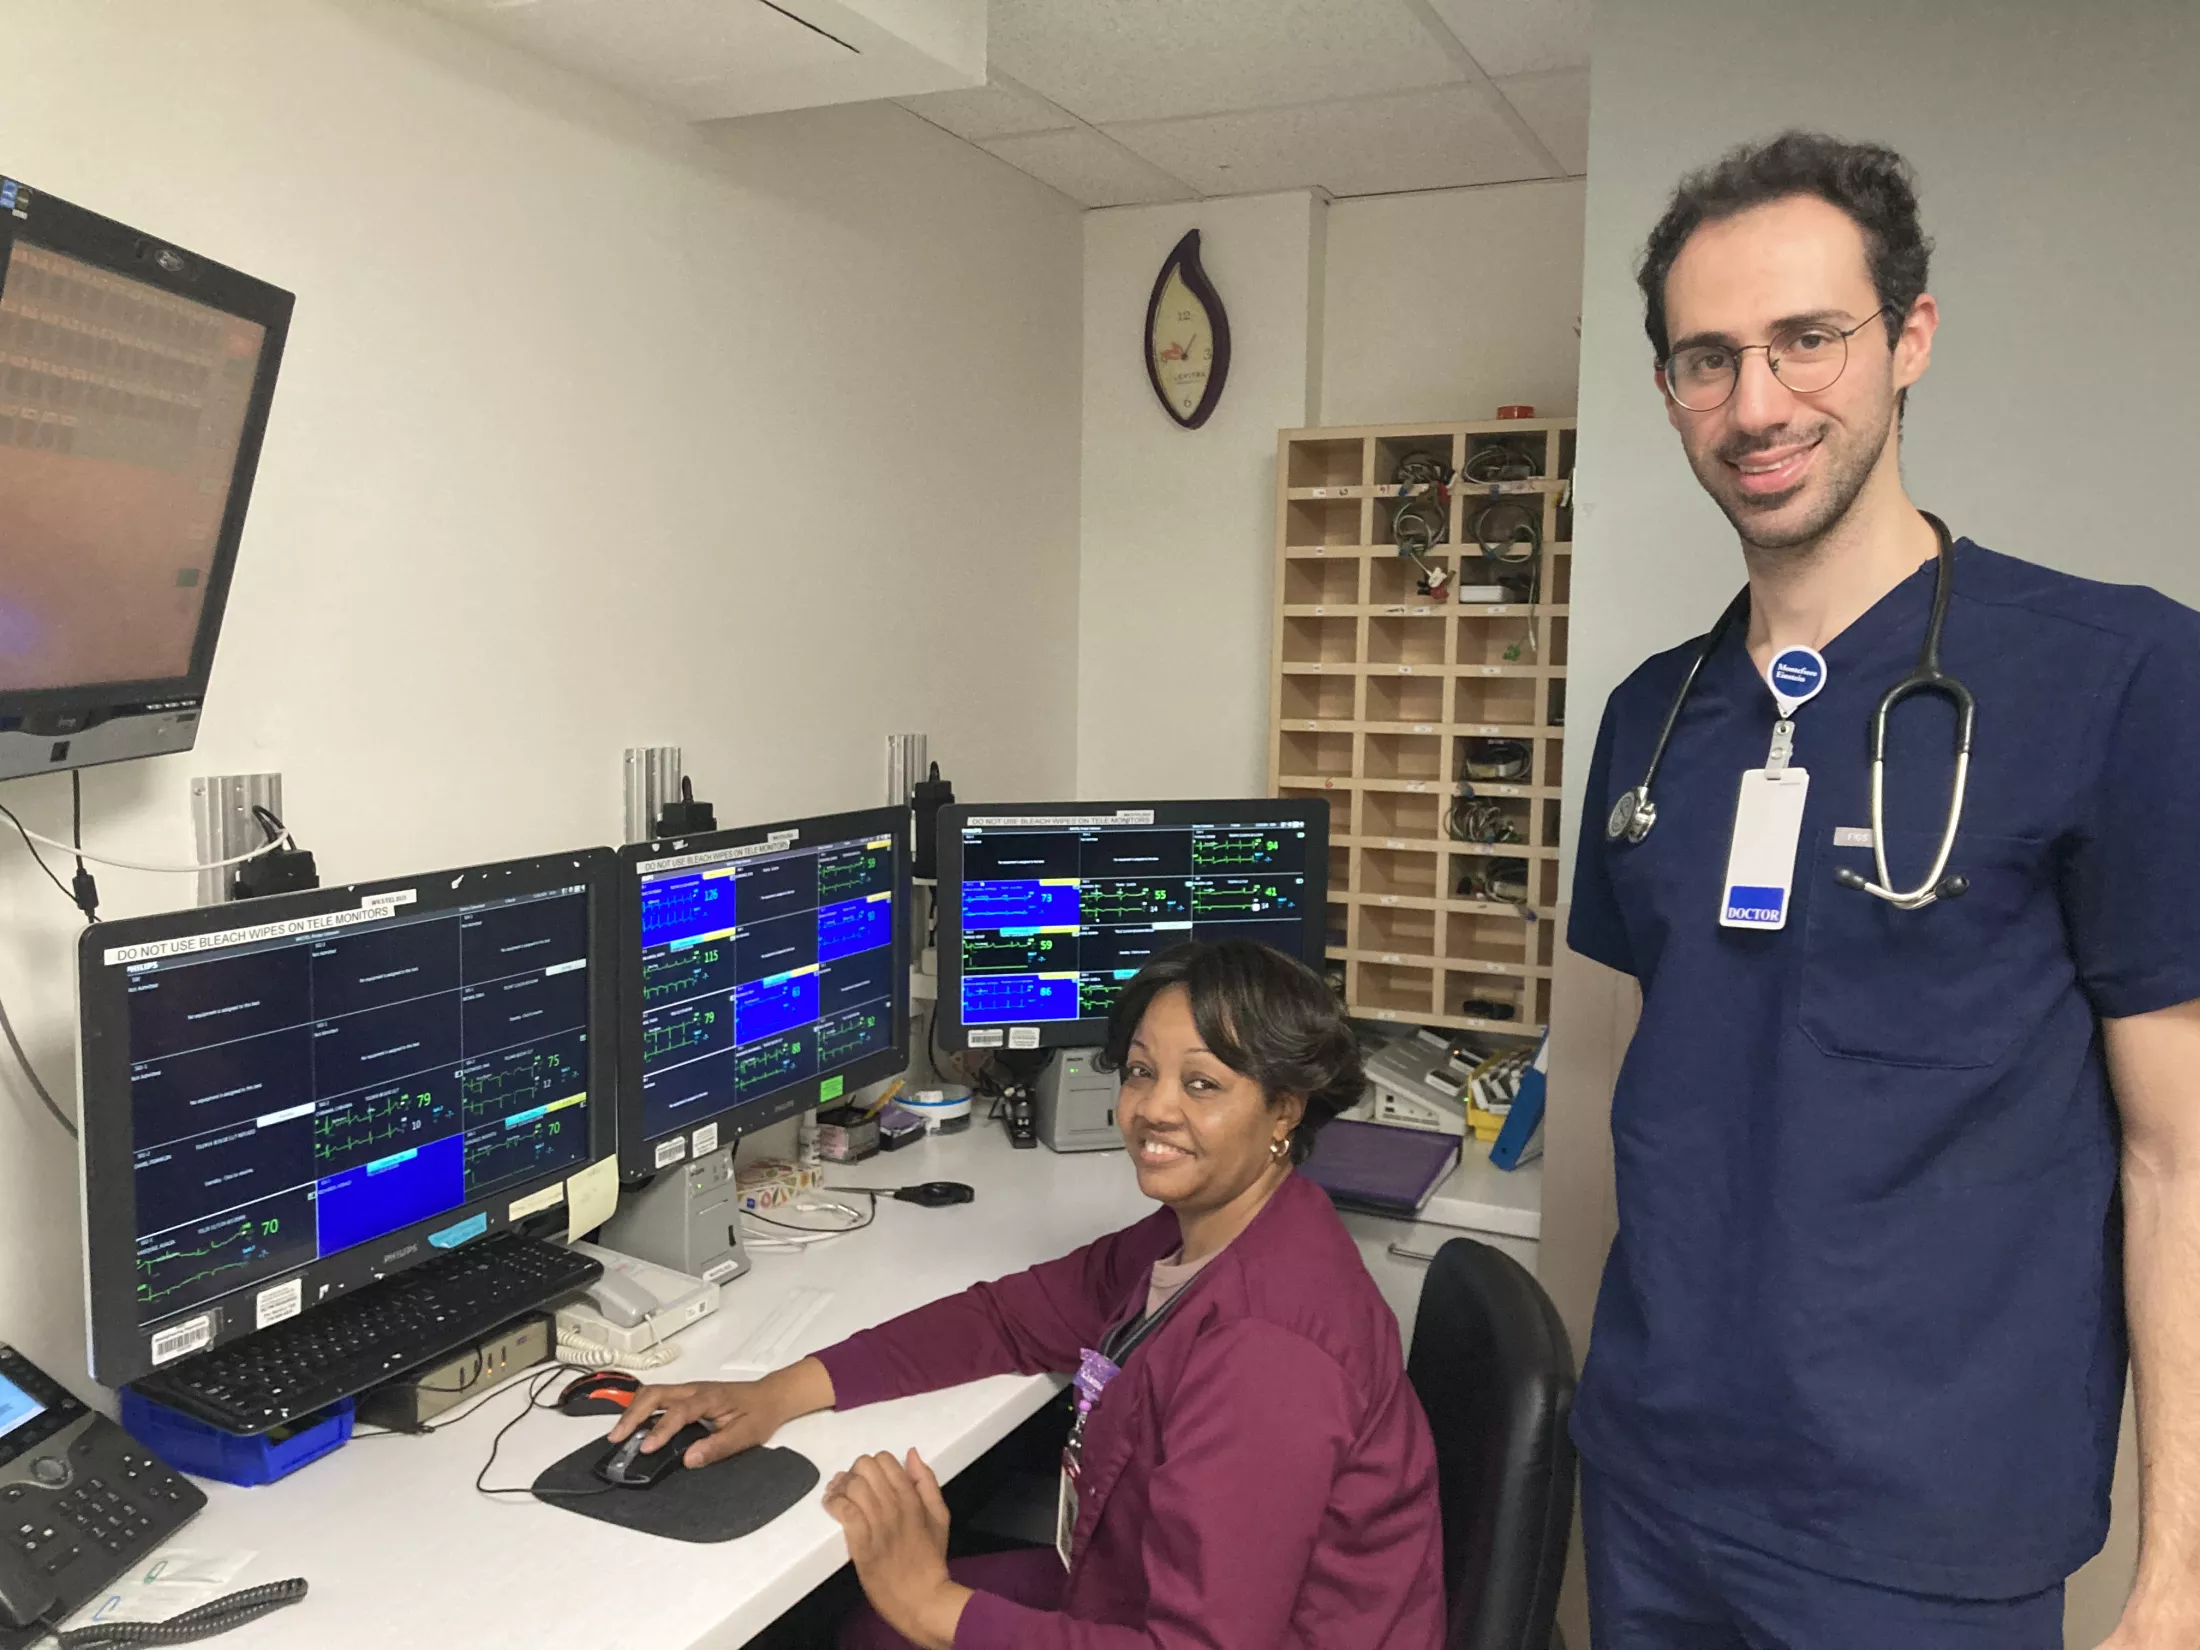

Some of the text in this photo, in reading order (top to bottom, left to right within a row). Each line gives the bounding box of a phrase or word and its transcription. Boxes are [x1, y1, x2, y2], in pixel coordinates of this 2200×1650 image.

[1178, 311, 1191, 321] 12
[1204, 348, 1212, 360] 3
[1183, 394, 1192, 408] 6
[1776, 670, 1806, 682] Einstein
[1778, 663, 1818, 676] Montefiore
[1848, 832, 1868, 842] FIGS
[645, 862, 655, 871] DO
[657, 860, 670, 870] NOT
[672, 858, 685, 867] USE
[687, 854, 712, 865] BLEACH
[713, 852, 732, 861] WIPES
[745, 847, 758, 855] TELE
[759, 842, 788, 853] MONITORS
[1041, 894, 1052, 903] 73
[1154, 890, 1166, 900] 55
[1265, 887, 1277, 897] 41
[1728, 907, 1780, 920] DOCTOR
[118, 950, 137, 961] DO
[141, 944, 168, 958] NOT
[171, 940, 194, 953] USE
[200, 932, 246, 948] BLEACH
[249, 924, 286, 940] WIPES
[289, 922, 304, 933] ON
[308, 916, 333, 929] TELE
[336, 907, 388, 924] MONITORS
[1040, 940, 1052, 950] 59
[704, 950, 718, 963] 115
[704, 1011, 715, 1024] 79
[548, 1054, 560, 1068] 75
[543, 1079, 552, 1088] 12
[417, 1092, 431, 1108] 79
[412, 1120, 421, 1130] 10
[548, 1122, 560, 1135] 70
[261, 1218, 279, 1236] 70
